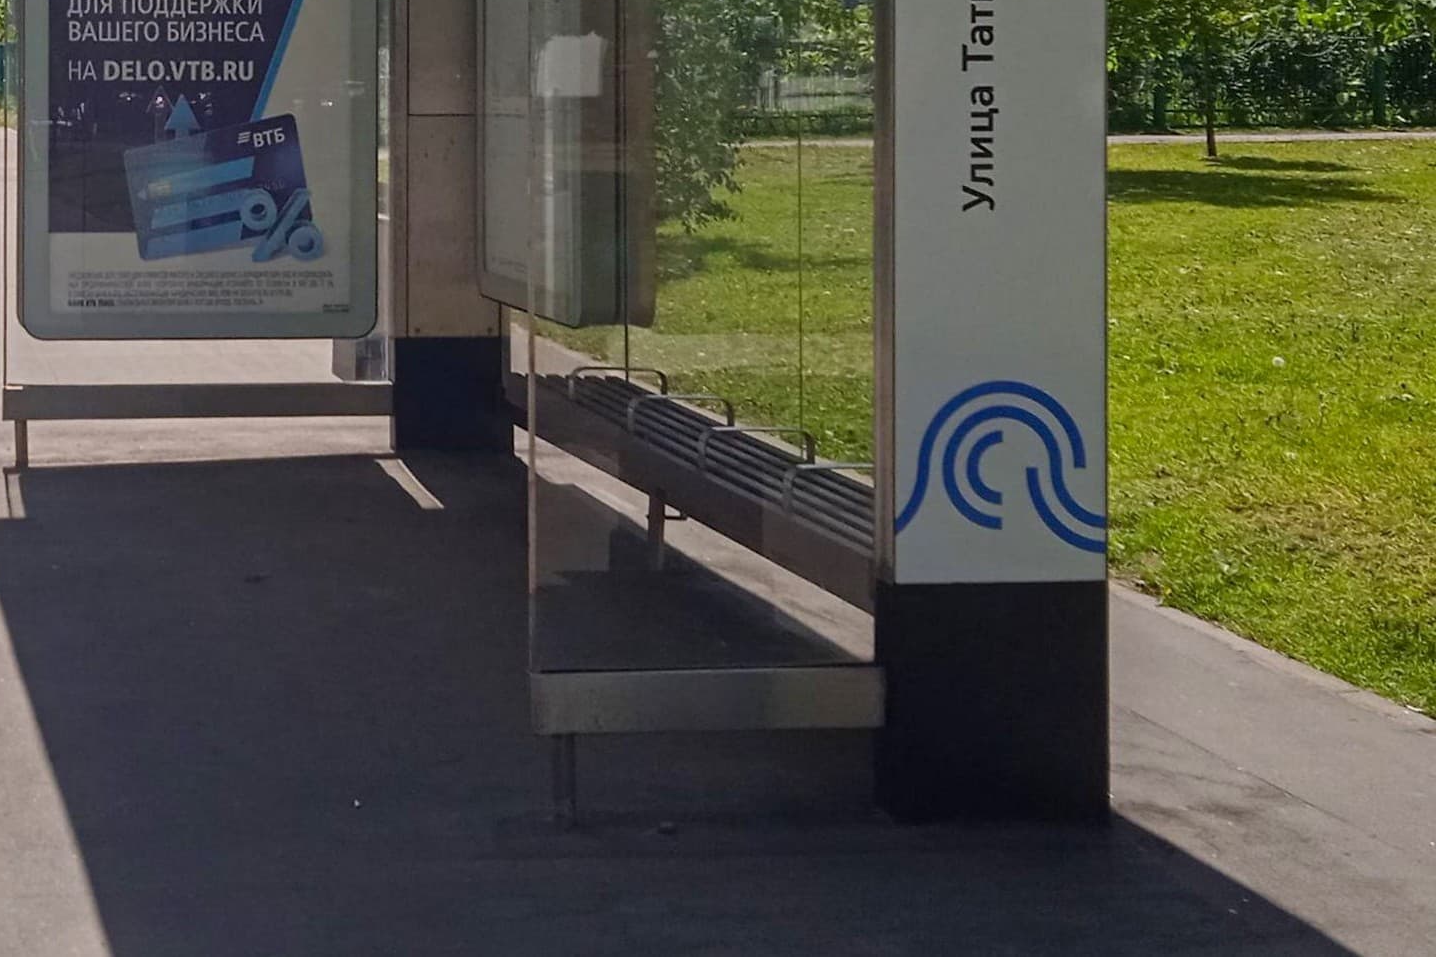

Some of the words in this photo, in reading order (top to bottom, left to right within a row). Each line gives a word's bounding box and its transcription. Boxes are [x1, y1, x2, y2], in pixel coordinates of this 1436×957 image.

[67, 21, 160, 43] ВАШЕГО
[166, 21, 265, 43] БИЗНЕСА
[67, 60, 97, 81] НА
[103, 60, 255, 82] DELO.VTB.RU
[252, 127, 285, 148] ВТБ
[961, 85, 1000, 212] Улица
